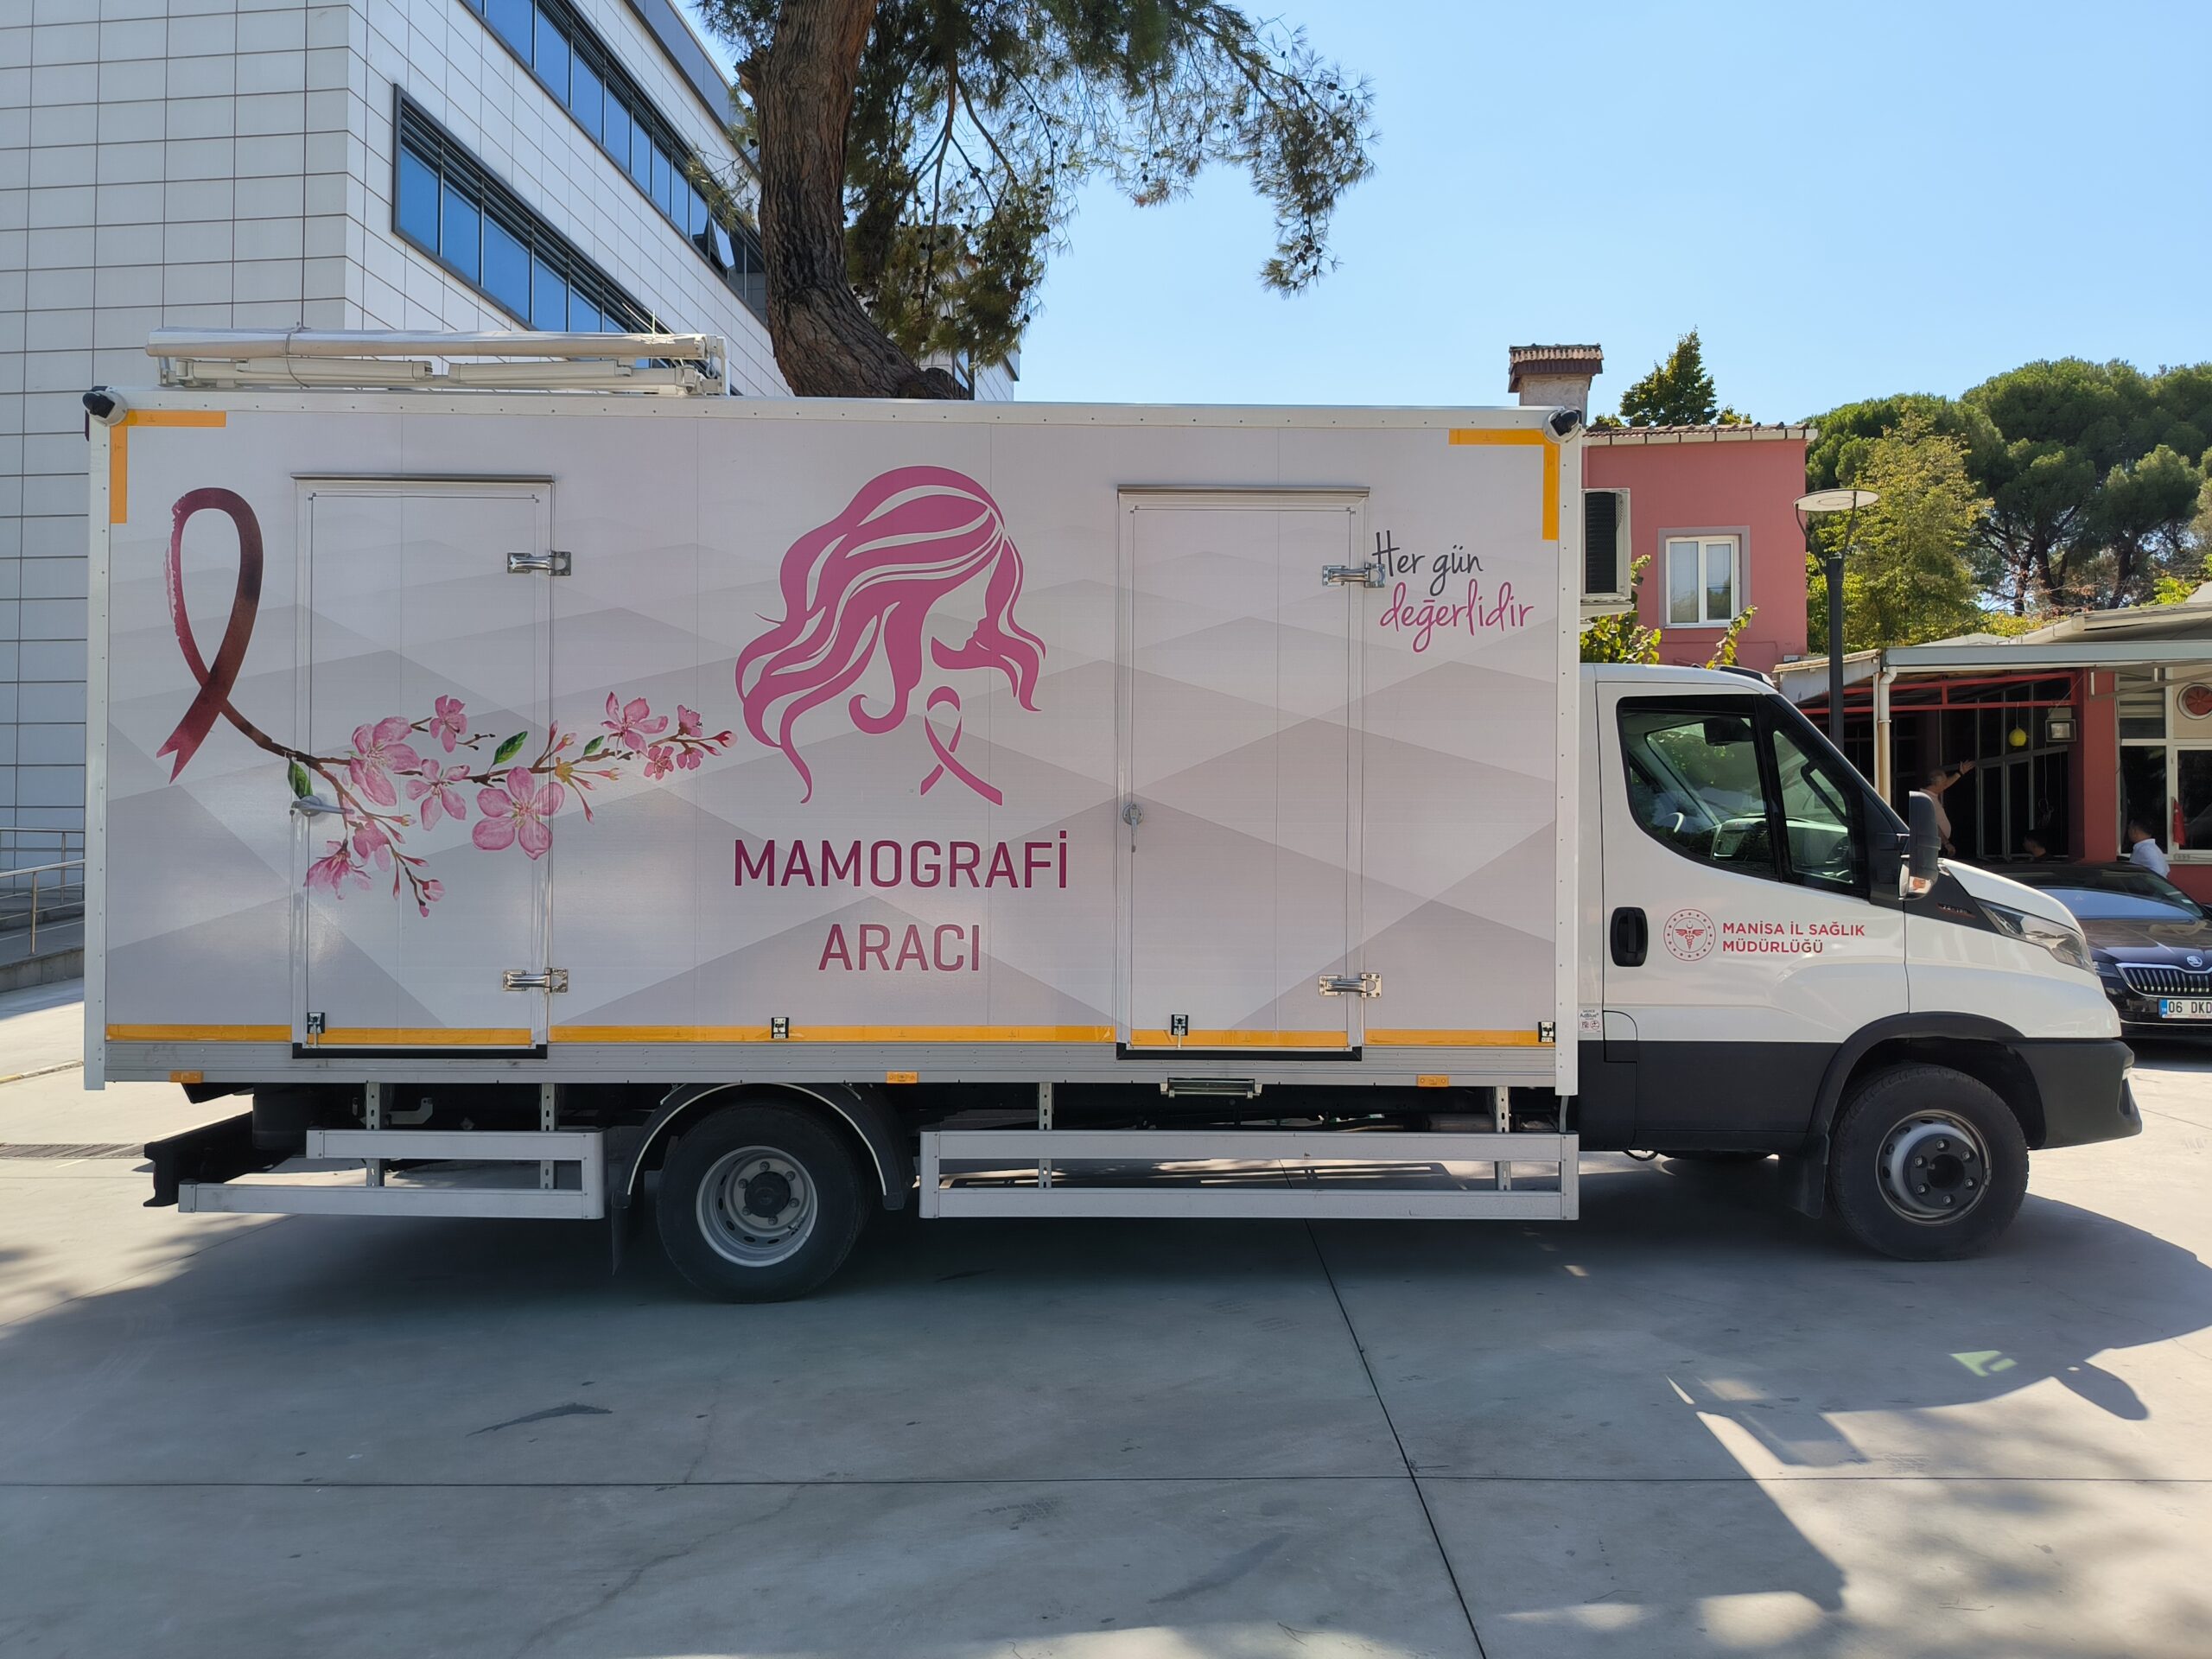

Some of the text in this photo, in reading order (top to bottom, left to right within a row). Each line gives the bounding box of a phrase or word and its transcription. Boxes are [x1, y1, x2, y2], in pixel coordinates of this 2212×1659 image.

[1372, 530, 1484, 597] Her gün
[1379, 578, 1535, 653] değerlidir
[734, 830, 1067, 888] MAMOGRAFİ
[818, 924, 980, 971] ARACI
[1722, 921, 1865, 936] MANİSA İL SAĞLIK
[1722, 938, 1823, 953] MÜDÜRLÜĞÜ
[2169, 1001, 2183, 1013] 06
